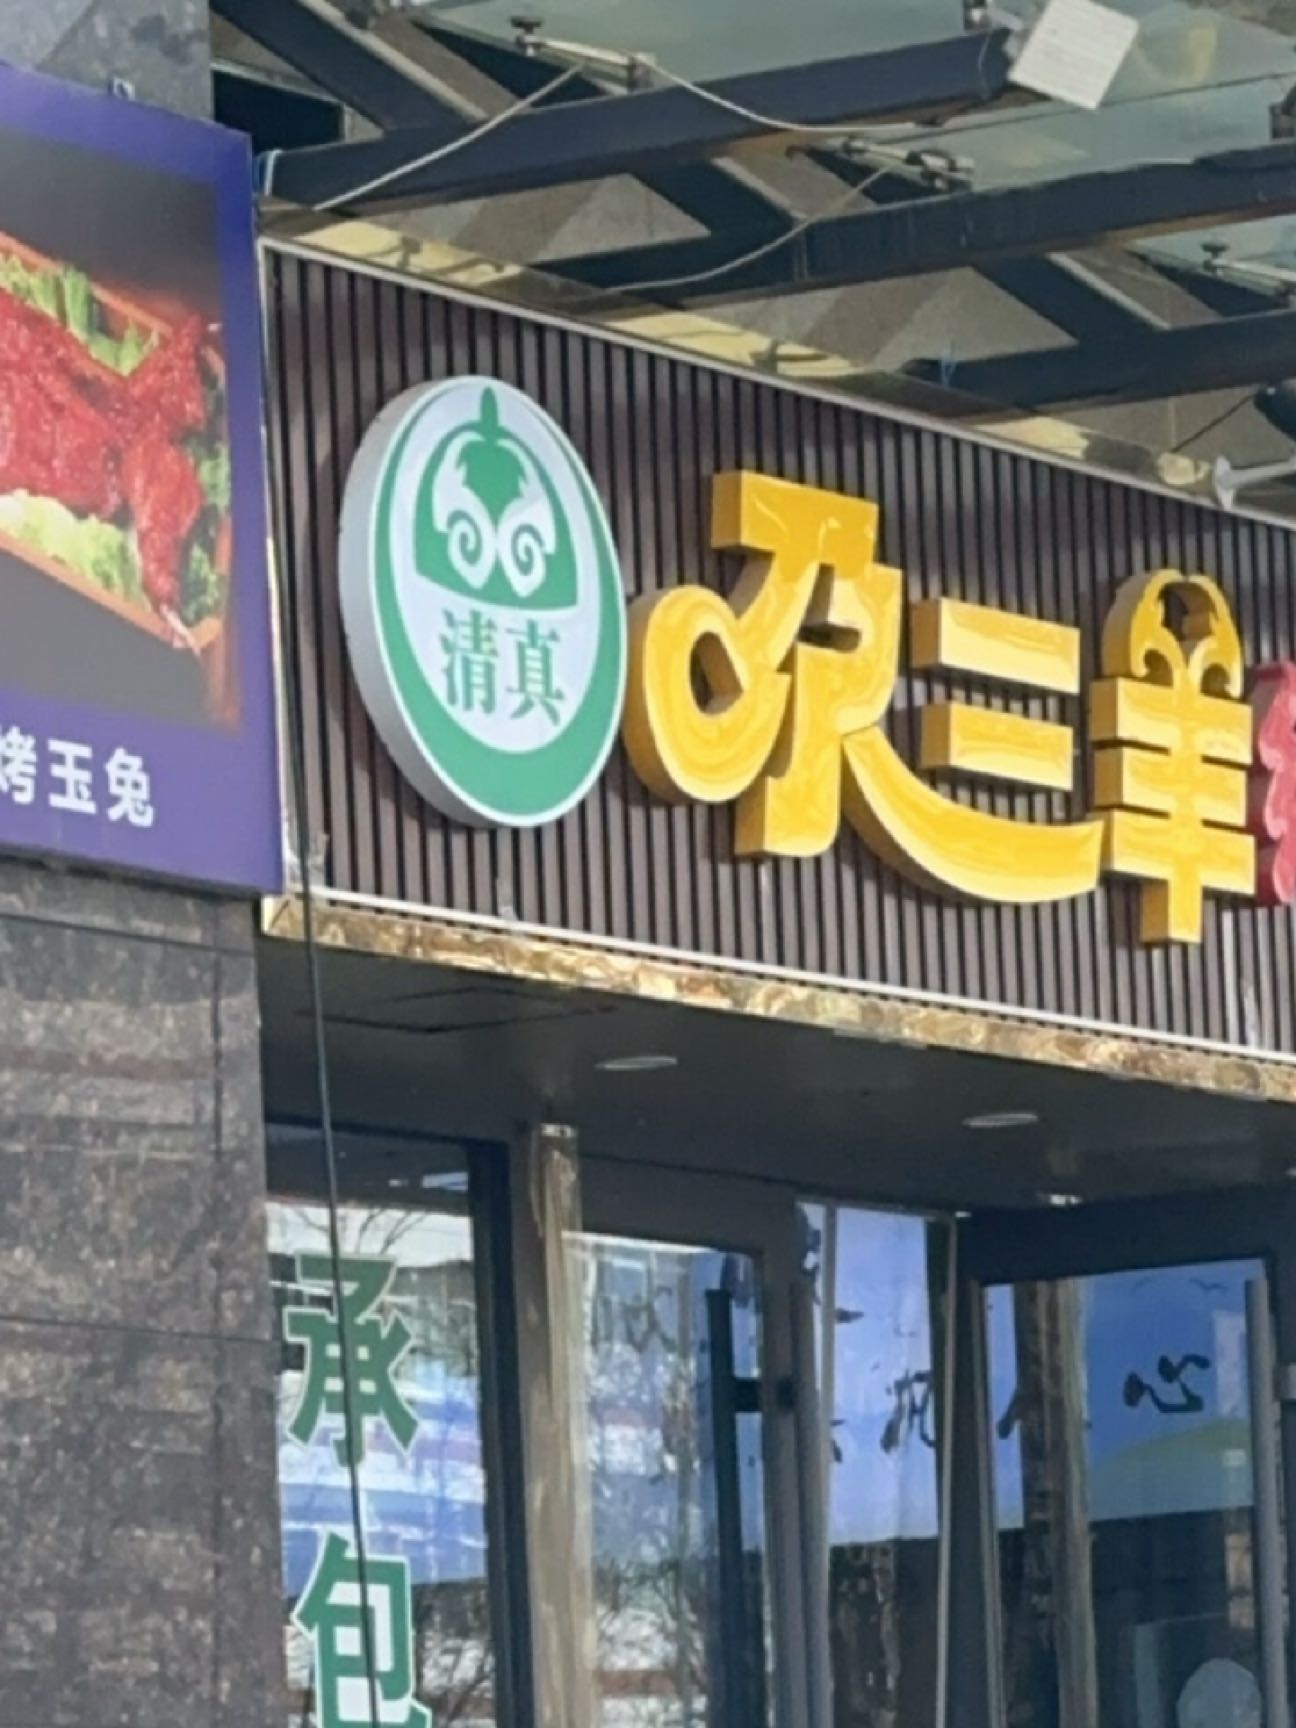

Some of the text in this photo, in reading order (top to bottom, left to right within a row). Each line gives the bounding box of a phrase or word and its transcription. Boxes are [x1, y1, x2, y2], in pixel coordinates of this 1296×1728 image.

[440, 607, 567, 728] 清真
[0, 725, 155, 828] 烤玉兔
